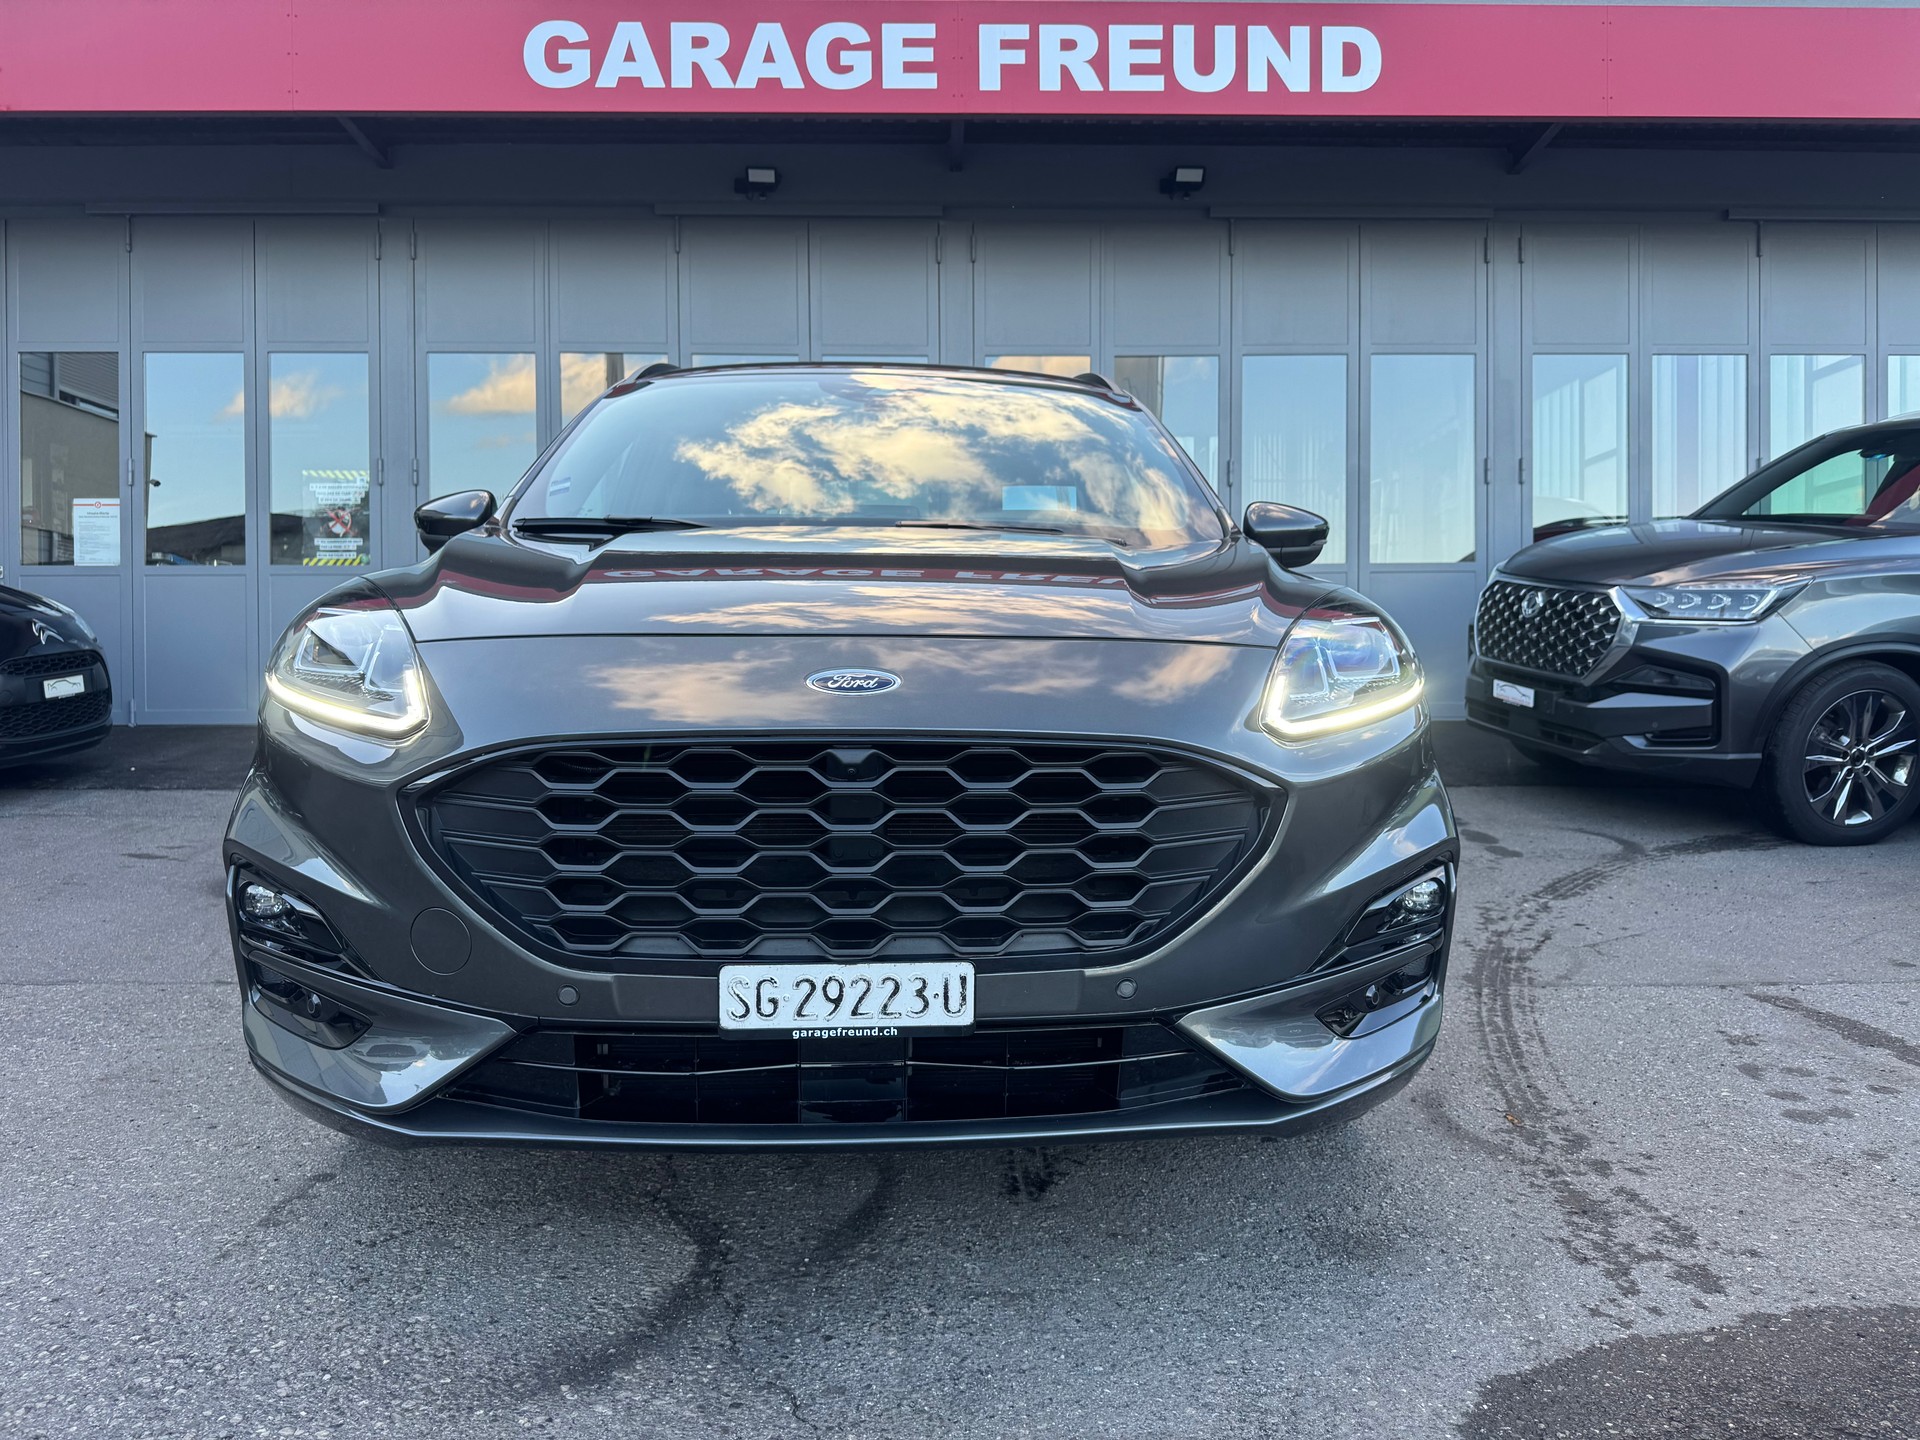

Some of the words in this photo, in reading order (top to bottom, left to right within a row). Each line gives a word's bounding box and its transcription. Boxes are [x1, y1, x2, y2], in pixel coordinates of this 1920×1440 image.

[523, 20, 938, 91] GARAGE
[978, 24, 1383, 94] FREUND
[827, 673, 879, 688] Ford
[792, 1027, 898, 1039] garagefreund.ch
